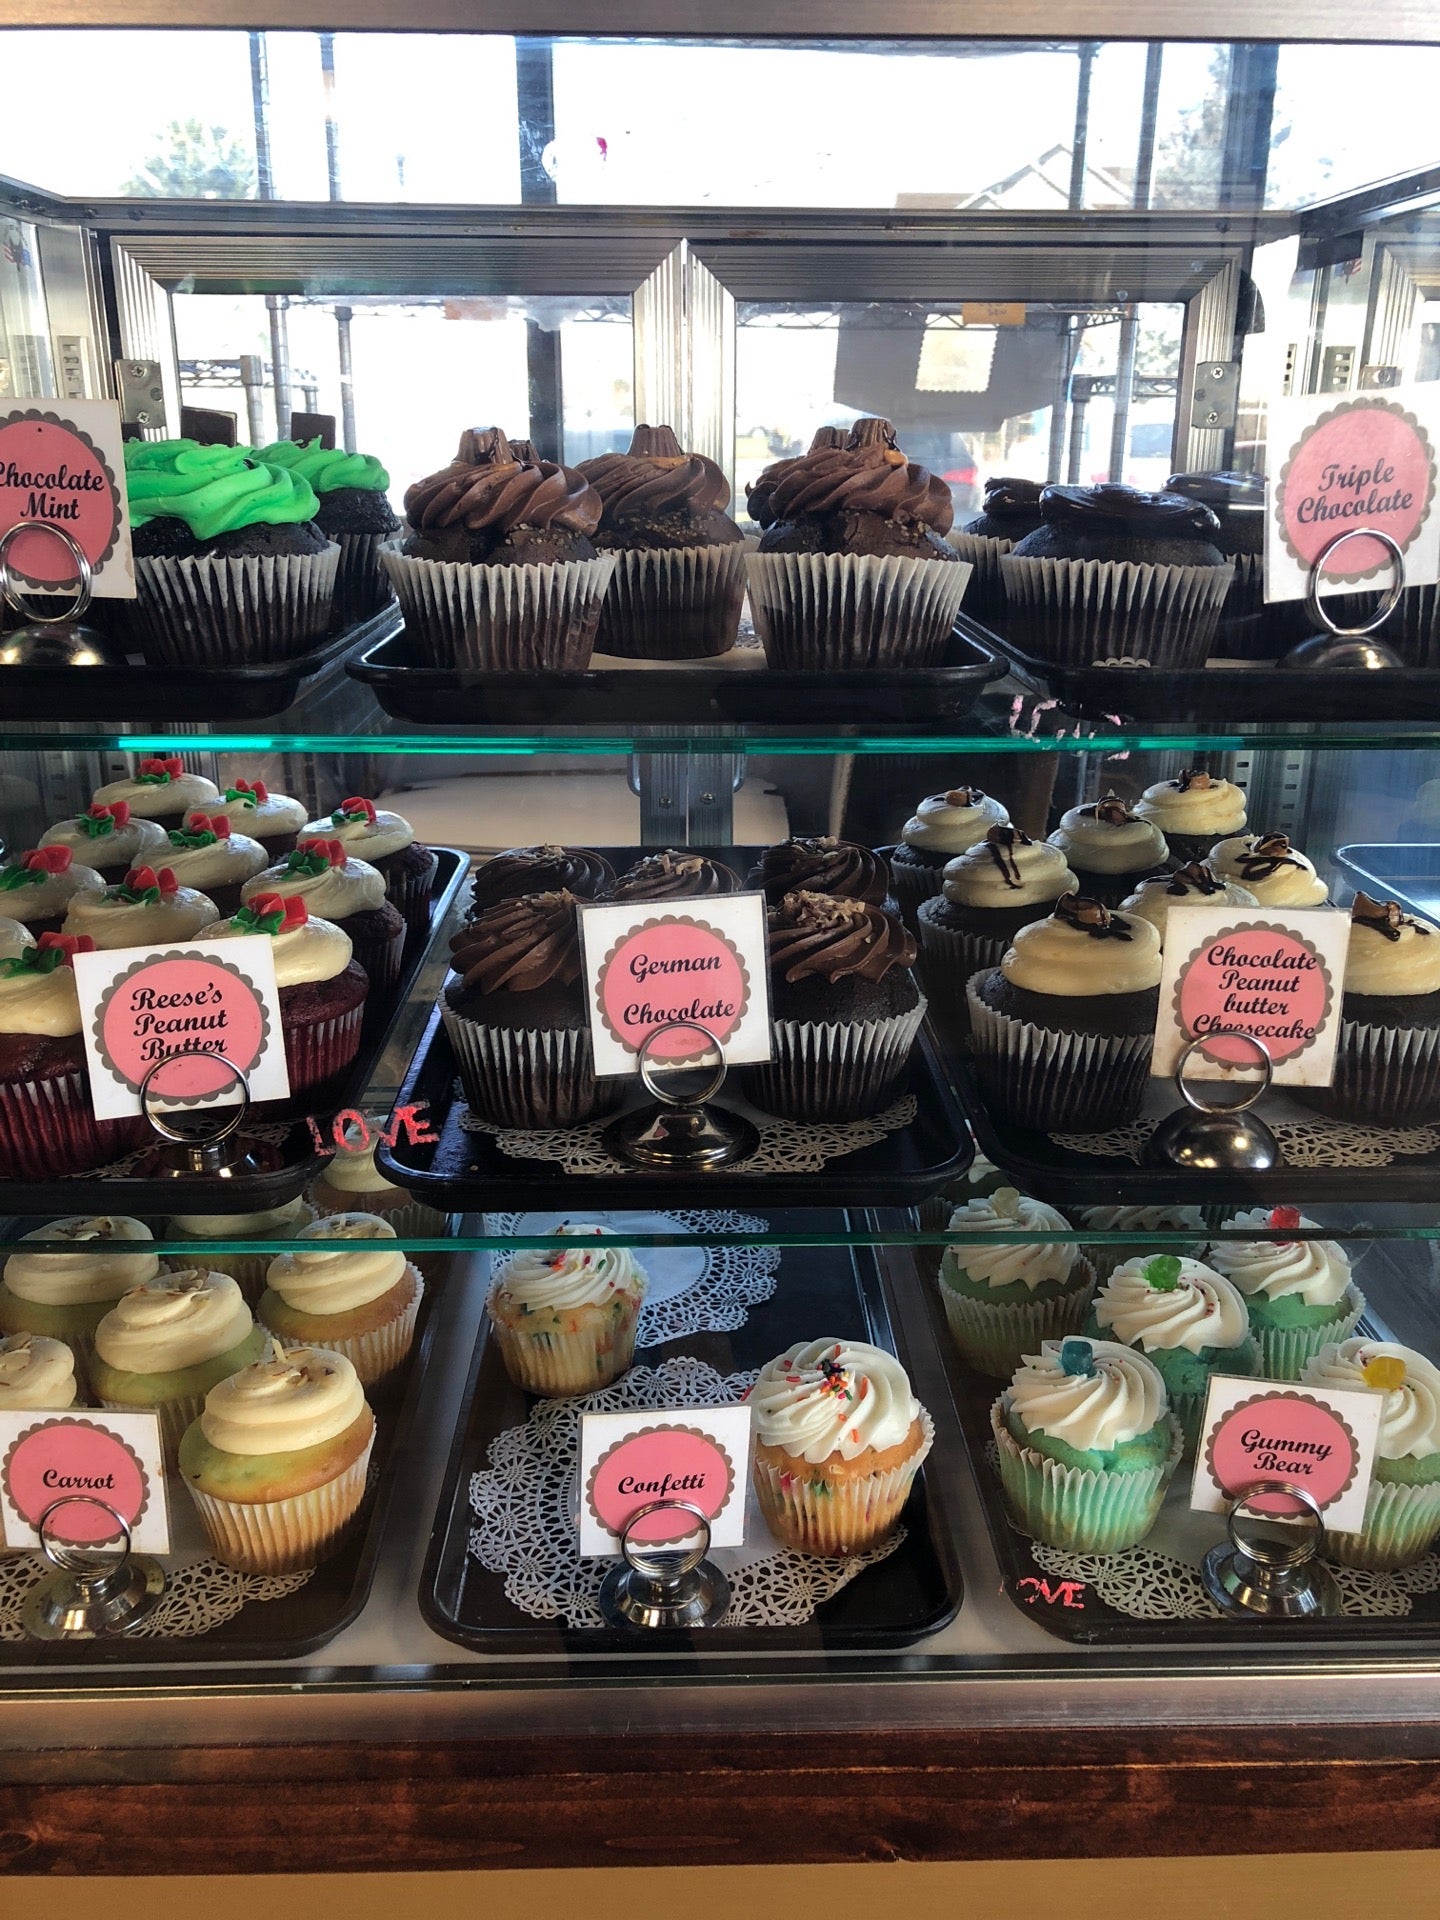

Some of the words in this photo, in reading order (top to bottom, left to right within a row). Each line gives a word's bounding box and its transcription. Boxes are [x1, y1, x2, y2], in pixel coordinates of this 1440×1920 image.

[1318, 457, 1395, 495] Triple
[20, 492, 80, 520] Mint
[1297, 488, 1413, 524] Chocolate
[629, 953, 722, 984] German
[1207, 945, 1318, 970] Chocolate
[1218, 969, 1300, 993] Peanut
[130, 982, 223, 1012] Reese's
[1223, 993, 1290, 1016] butter
[133, 1009, 229, 1037] Peanut
[623, 998, 736, 1026] Chocolate
[305, 1100, 441, 1157] LOVE
[1240, 1429, 1334, 1462] Gummy
[1253, 1452, 1313, 1475] Bear
[42, 1468, 116, 1490] Carrot
[617, 1473, 706, 1498] Confetti
